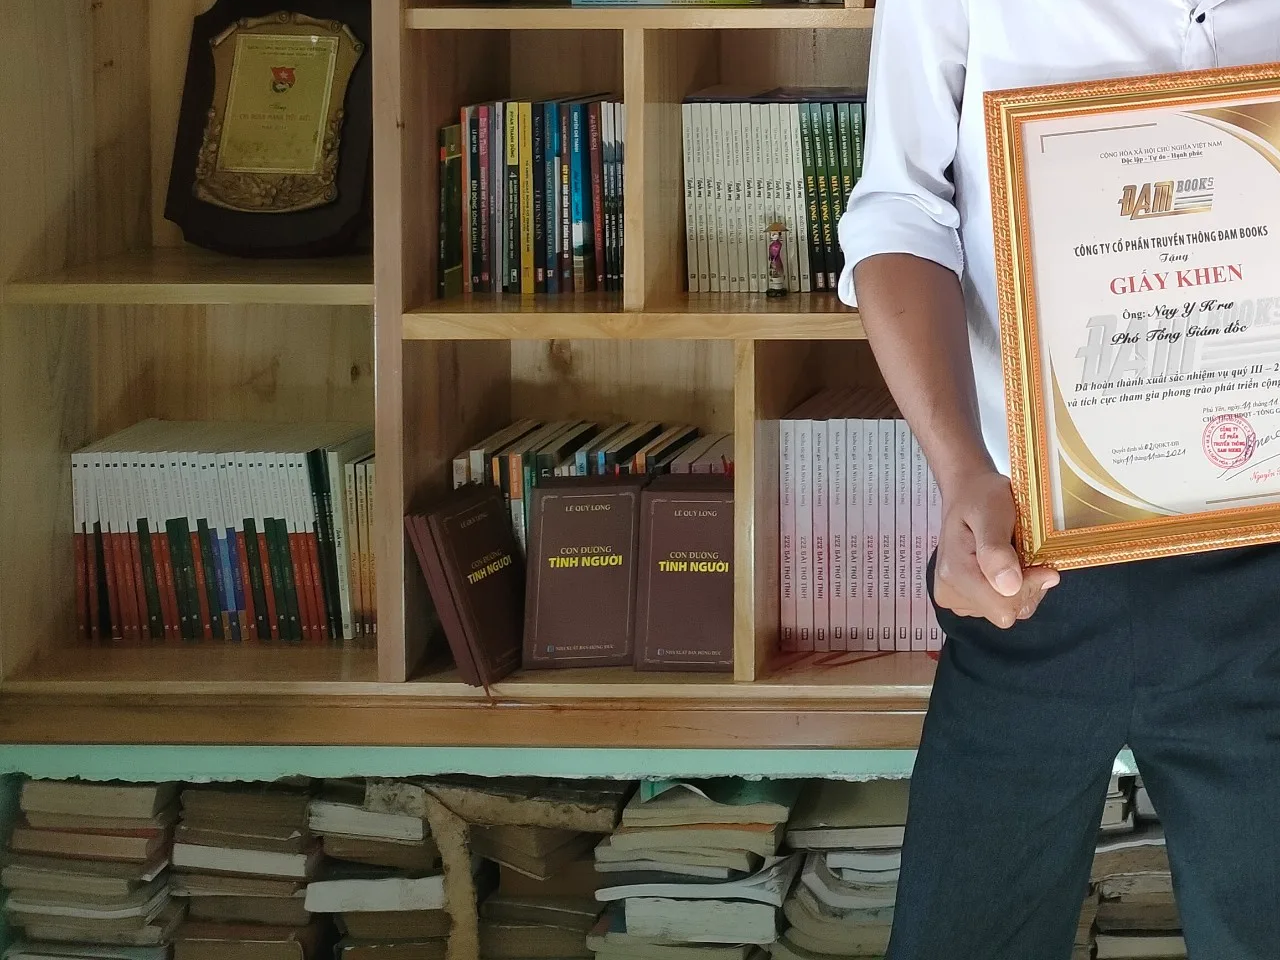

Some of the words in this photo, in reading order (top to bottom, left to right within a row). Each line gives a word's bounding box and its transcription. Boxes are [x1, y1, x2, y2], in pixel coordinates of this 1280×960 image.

[1100, 151, 1118, 160] CỘNG
[1133, 147, 1143, 155] XÃ
[1144, 146, 1156, 155] HỘI
[1172, 143, 1191, 152] NGHĨA
[1192, 141, 1207, 150] VIỆT
[1117, 180, 1174, 220] ĐAM
[1176, 177, 1215, 193] BOOKS
[1074, 242, 1098, 257] CÔNG
[1100, 243, 1111, 254] TY
[1112, 237, 1123, 253] CỔ
[1125, 234, 1149, 251] PHẦN
[1151, 231, 1185, 249] TRUYỀN
[1187, 230, 1216, 245] THÔNG
[1218, 228, 1238, 241] ĐAM
[1240, 225, 1269, 239] BOOKS
[1159, 253, 1189, 263] Tặng
[1110, 269, 1169, 295] GIẤY
[1175, 264, 1243, 288] KHEN
[1122, 309, 1146, 320] Ông:
[1148, 305, 1180, 319] Nay
[1181, 302, 1197, 318] Y
[1110, 334, 1141, 346] Phó
[1146, 328, 1182, 344] Tổng
[1186, 324, 1221, 338] Giám
[1224, 320, 1248, 334] đốc
[1075, 381, 1089, 393] Đã
[1091, 380, 1114, 391] hoàn
[1116, 377, 1144, 388] thành
[1146, 372, 1167, 385] xuất
[1169, 371, 1184, 384] sắc
[1186, 369, 1215, 382] nhiệm
[1218, 369, 1229, 380] vụ
[1231, 366, 1248, 378] quý
[1251, 365, 1263, 374] III
[1067, 398, 1078, 408] và
[1080, 396, 1097, 407] tích
[1100, 394, 1117, 405] cực
[1119, 392, 1143, 403] tham
[1145, 390, 1160, 401] gia
[1162, 387, 1192, 401] phong
[1194, 384, 1212, 394] trào
[1214, 382, 1235, 395] phát
[1238, 378, 1259, 390] triển
[549, 556, 579, 568] TÌNH
[581, 554, 623, 567] NGƯỜI
[658, 561, 688, 572] TÌNH
[690, 560, 729, 573] NGƯỜI
